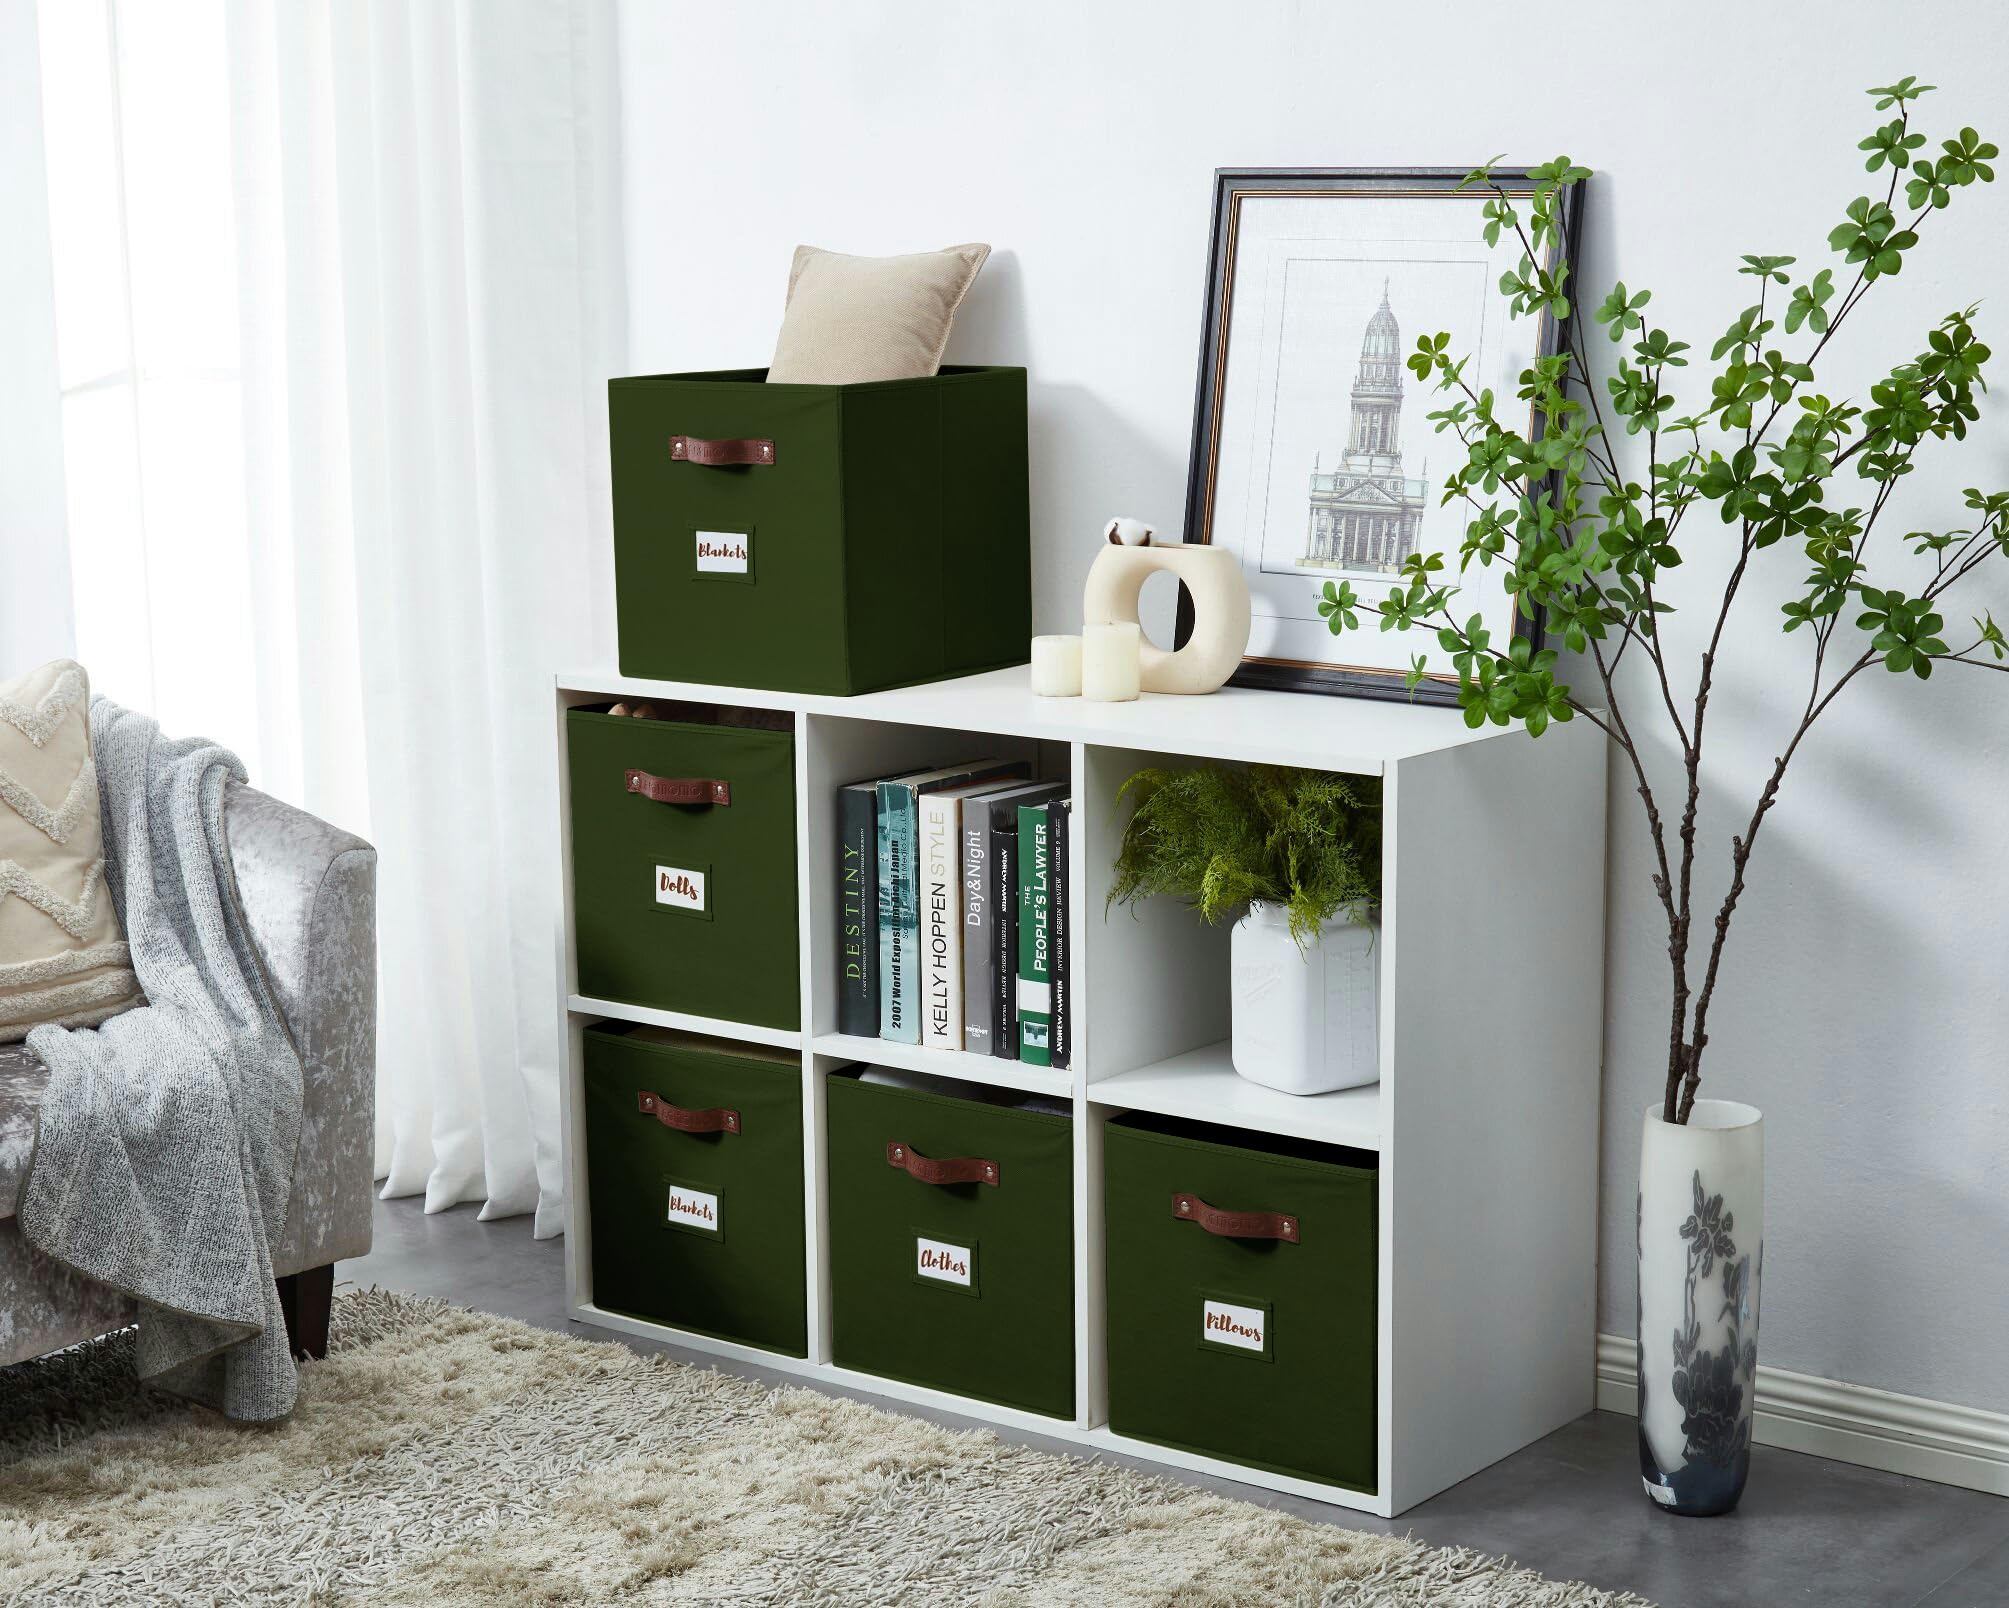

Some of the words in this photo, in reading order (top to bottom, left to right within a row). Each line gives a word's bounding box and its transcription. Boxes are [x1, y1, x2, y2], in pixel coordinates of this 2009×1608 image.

[698, 542, 747, 560] Blankets
[891, 840, 900, 873] Japan
[930, 811, 945, 877] STYLE
[1033, 823, 1047, 892] LAWYER
[661, 872, 699, 901] Dolls
[967, 830, 985, 926] Day&Night
[845, 844, 861, 980] DESTINY
[891, 905, 902, 964] Exposition
[931, 882, 947, 969] HOPPEN
[1034, 895, 1047, 972] PEOPLE'S
[892, 965, 902, 999] World
[933, 973, 948, 1036] KELLY
[892, 1000, 902, 1029] 2007
[670, 1195, 714, 1221] Blankets
[921, 1249, 967, 1276] Clothes
[1206, 1311, 1263, 1342] Pillows
